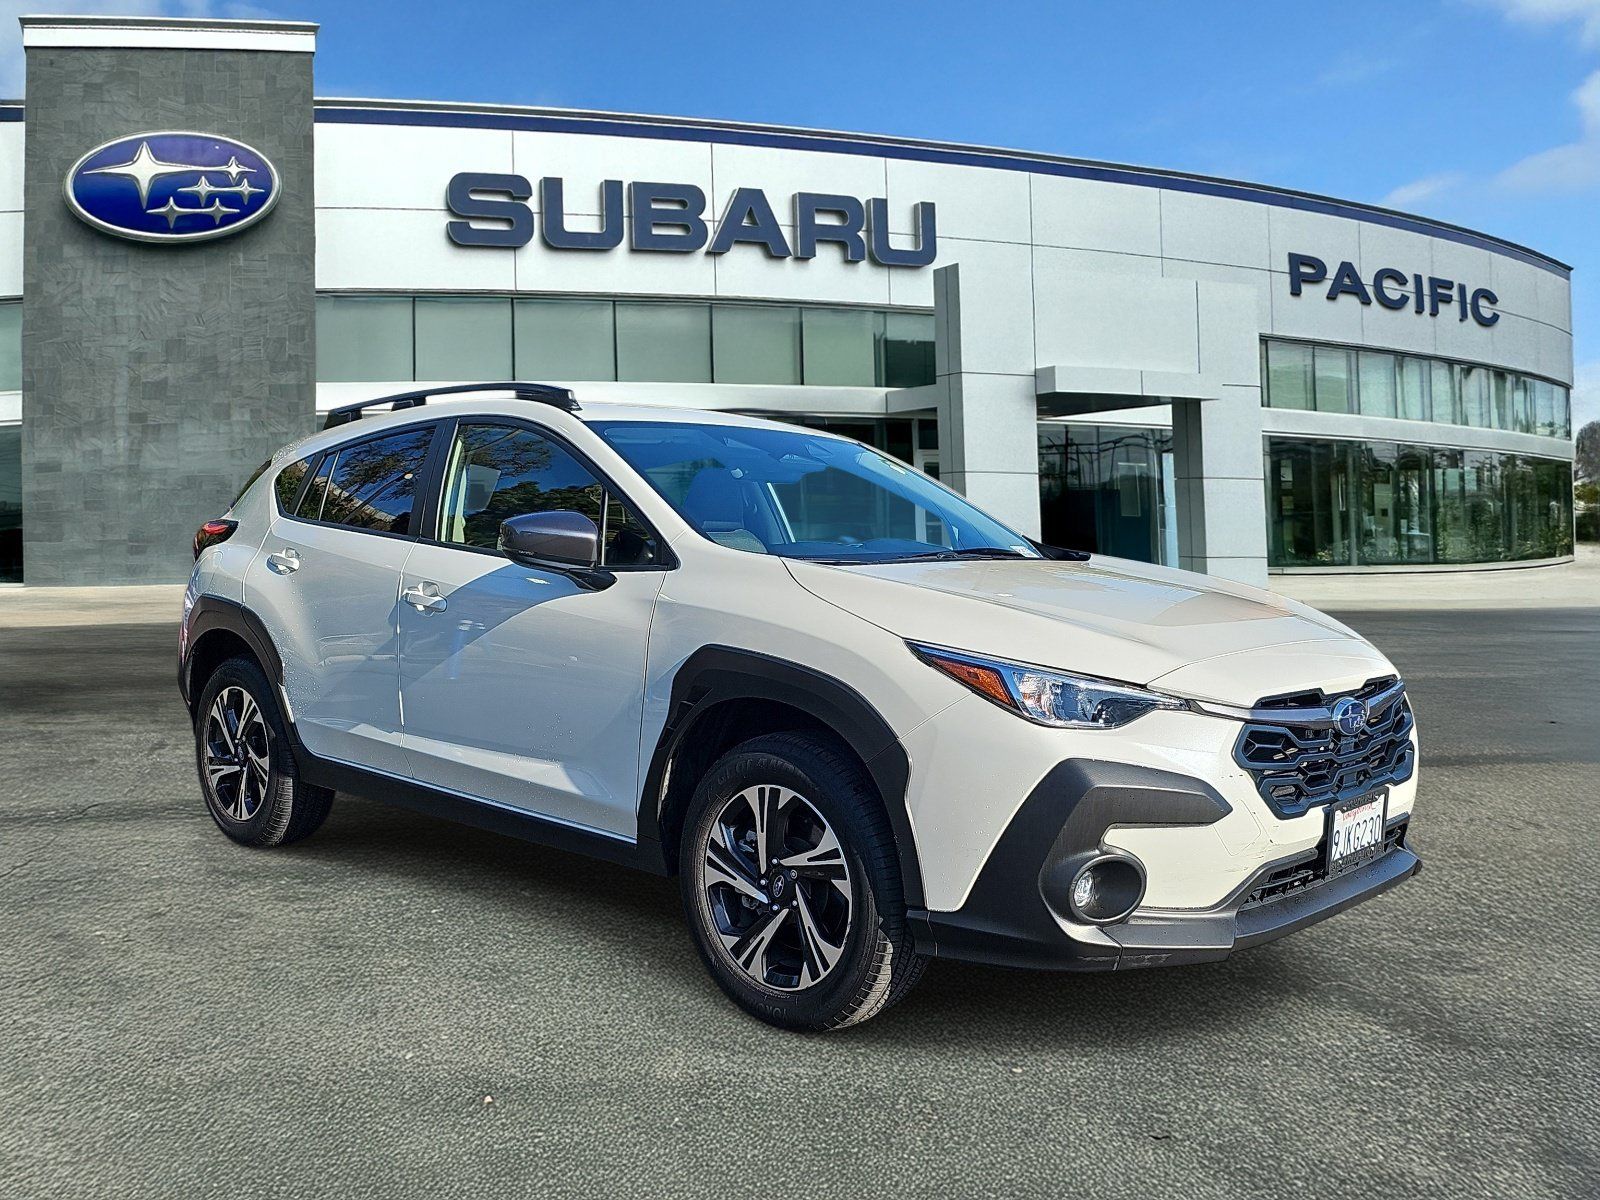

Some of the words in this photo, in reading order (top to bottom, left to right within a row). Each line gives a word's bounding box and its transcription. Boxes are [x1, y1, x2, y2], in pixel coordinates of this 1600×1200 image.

[446, 172, 937, 268] SUBARU
[1288, 252, 1500, 327] PACIFIC
[1332, 814, 1381, 860] 9JKG230
